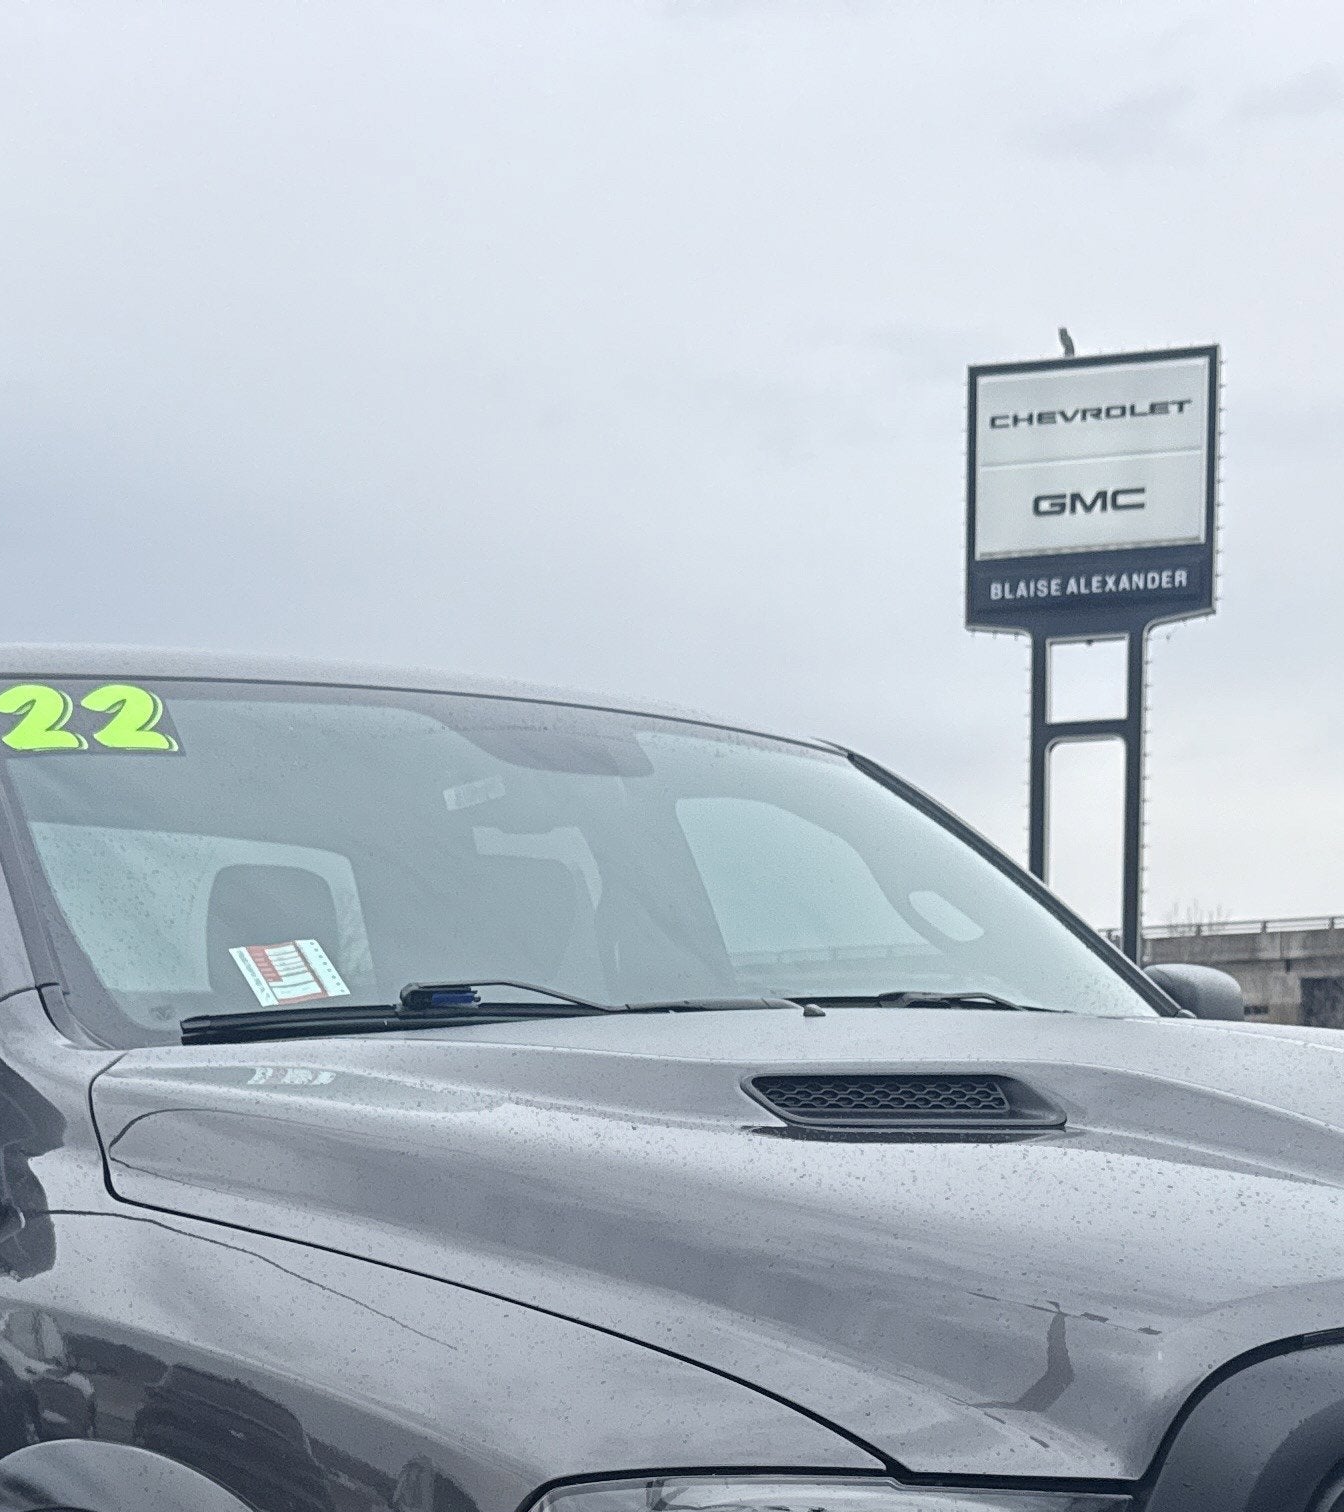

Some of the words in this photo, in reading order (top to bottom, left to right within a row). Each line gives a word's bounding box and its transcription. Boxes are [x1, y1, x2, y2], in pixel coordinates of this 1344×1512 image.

[989, 399, 1193, 430] CHEVROLET
[1032, 487, 1146, 517] GMC
[989, 577, 1062, 601] BLAISE
[1065, 568, 1189, 596] ALEXANDER
